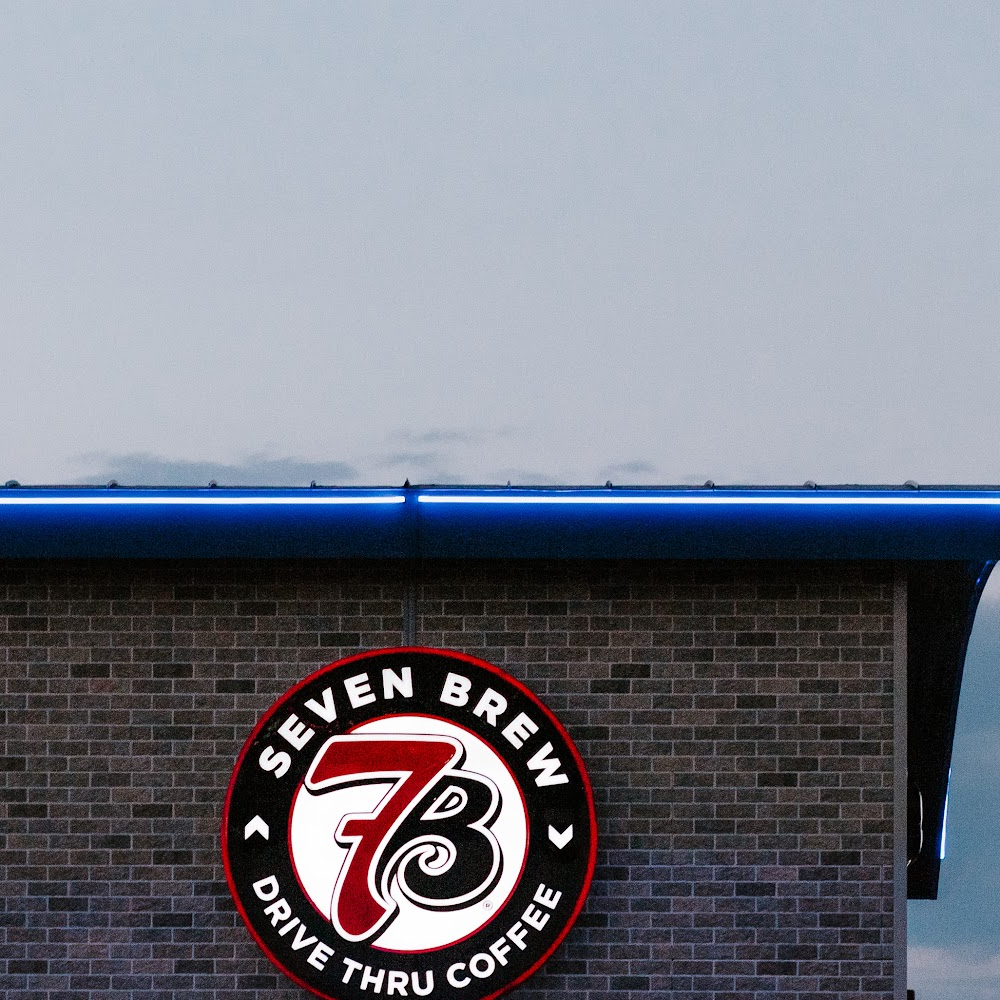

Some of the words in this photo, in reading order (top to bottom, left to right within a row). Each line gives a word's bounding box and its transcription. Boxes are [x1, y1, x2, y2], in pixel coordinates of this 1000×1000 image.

[259, 667, 413, 779] SEVEN
[440, 672, 569, 788] BREW
[252, 875, 336, 972] DRIVE
[342, 958, 434, 996] THRU
[446, 883, 562, 989] COFFEE
